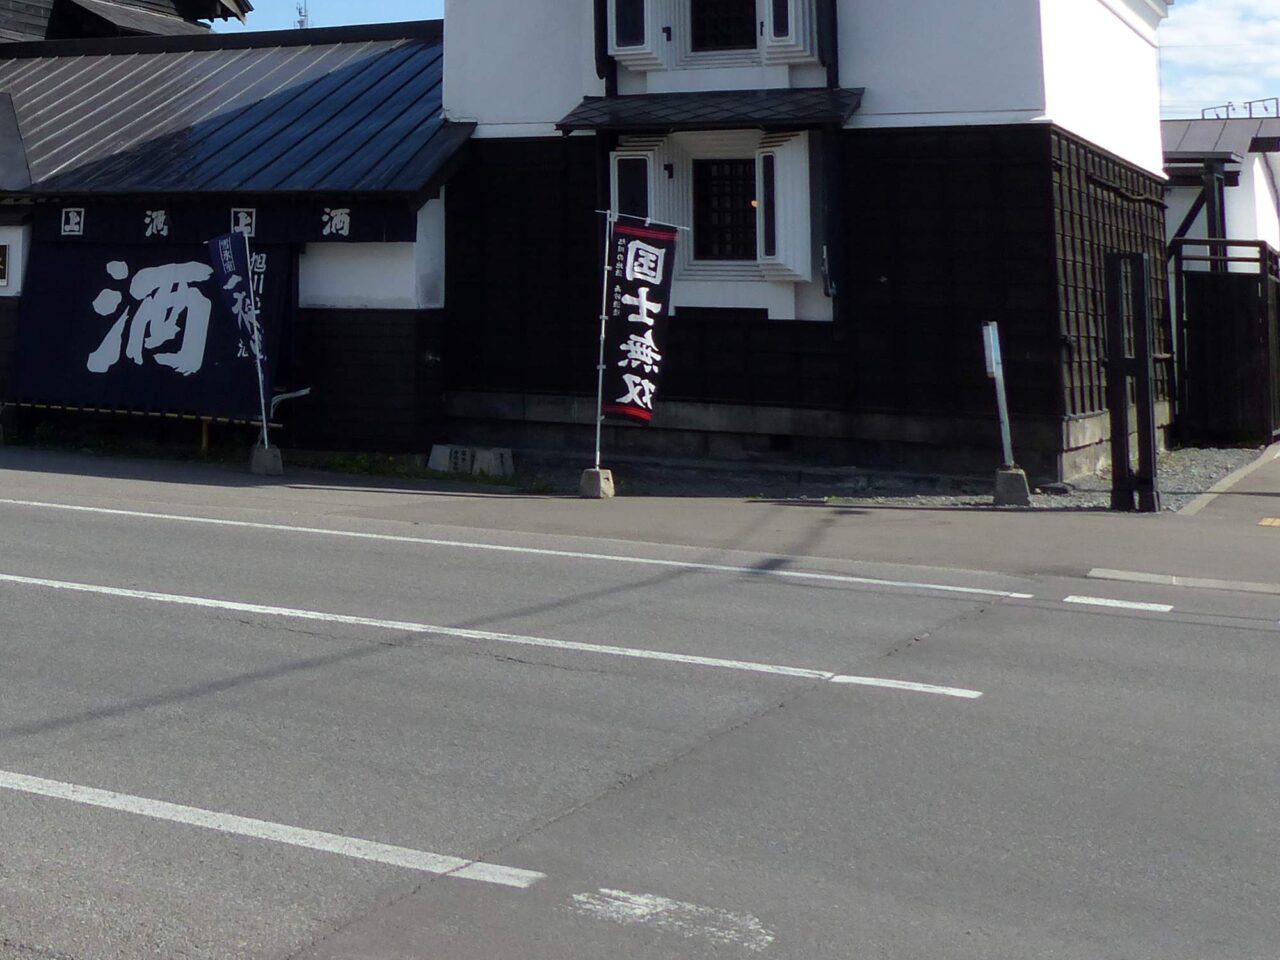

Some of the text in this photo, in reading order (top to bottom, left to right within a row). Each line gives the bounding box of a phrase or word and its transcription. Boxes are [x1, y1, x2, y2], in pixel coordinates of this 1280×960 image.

[144, 210, 168, 236] 酒
[322, 208, 350, 236] 酒
[87, 260, 214, 376] 酒
